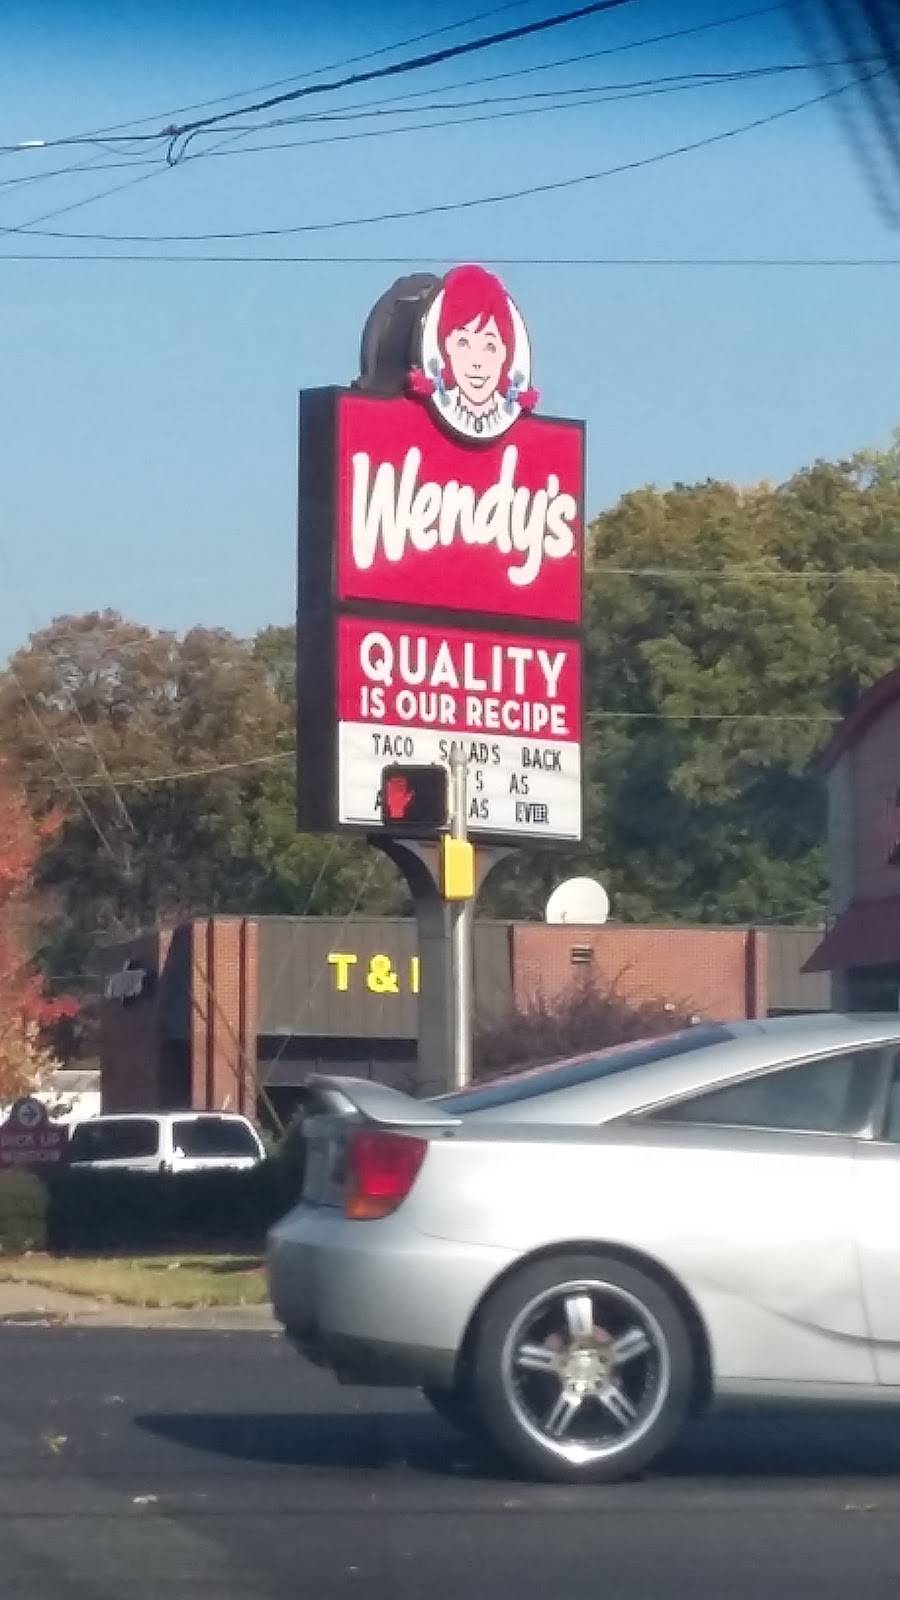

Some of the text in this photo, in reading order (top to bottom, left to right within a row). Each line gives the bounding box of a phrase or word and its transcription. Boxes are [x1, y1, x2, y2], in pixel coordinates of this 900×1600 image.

[352, 444, 577, 586] Wendy's
[360, 631, 566, 698] QUALITY
[360, 686, 569, 735] IS OUR RECIPE
[372, 733, 414, 757] TACO
[521, 746, 561, 771] BACK
[509, 772, 529, 795] AS
[469, 798, 489, 819] AS
[328, 953, 358, 992] T
[367, 954, 399, 993] &
